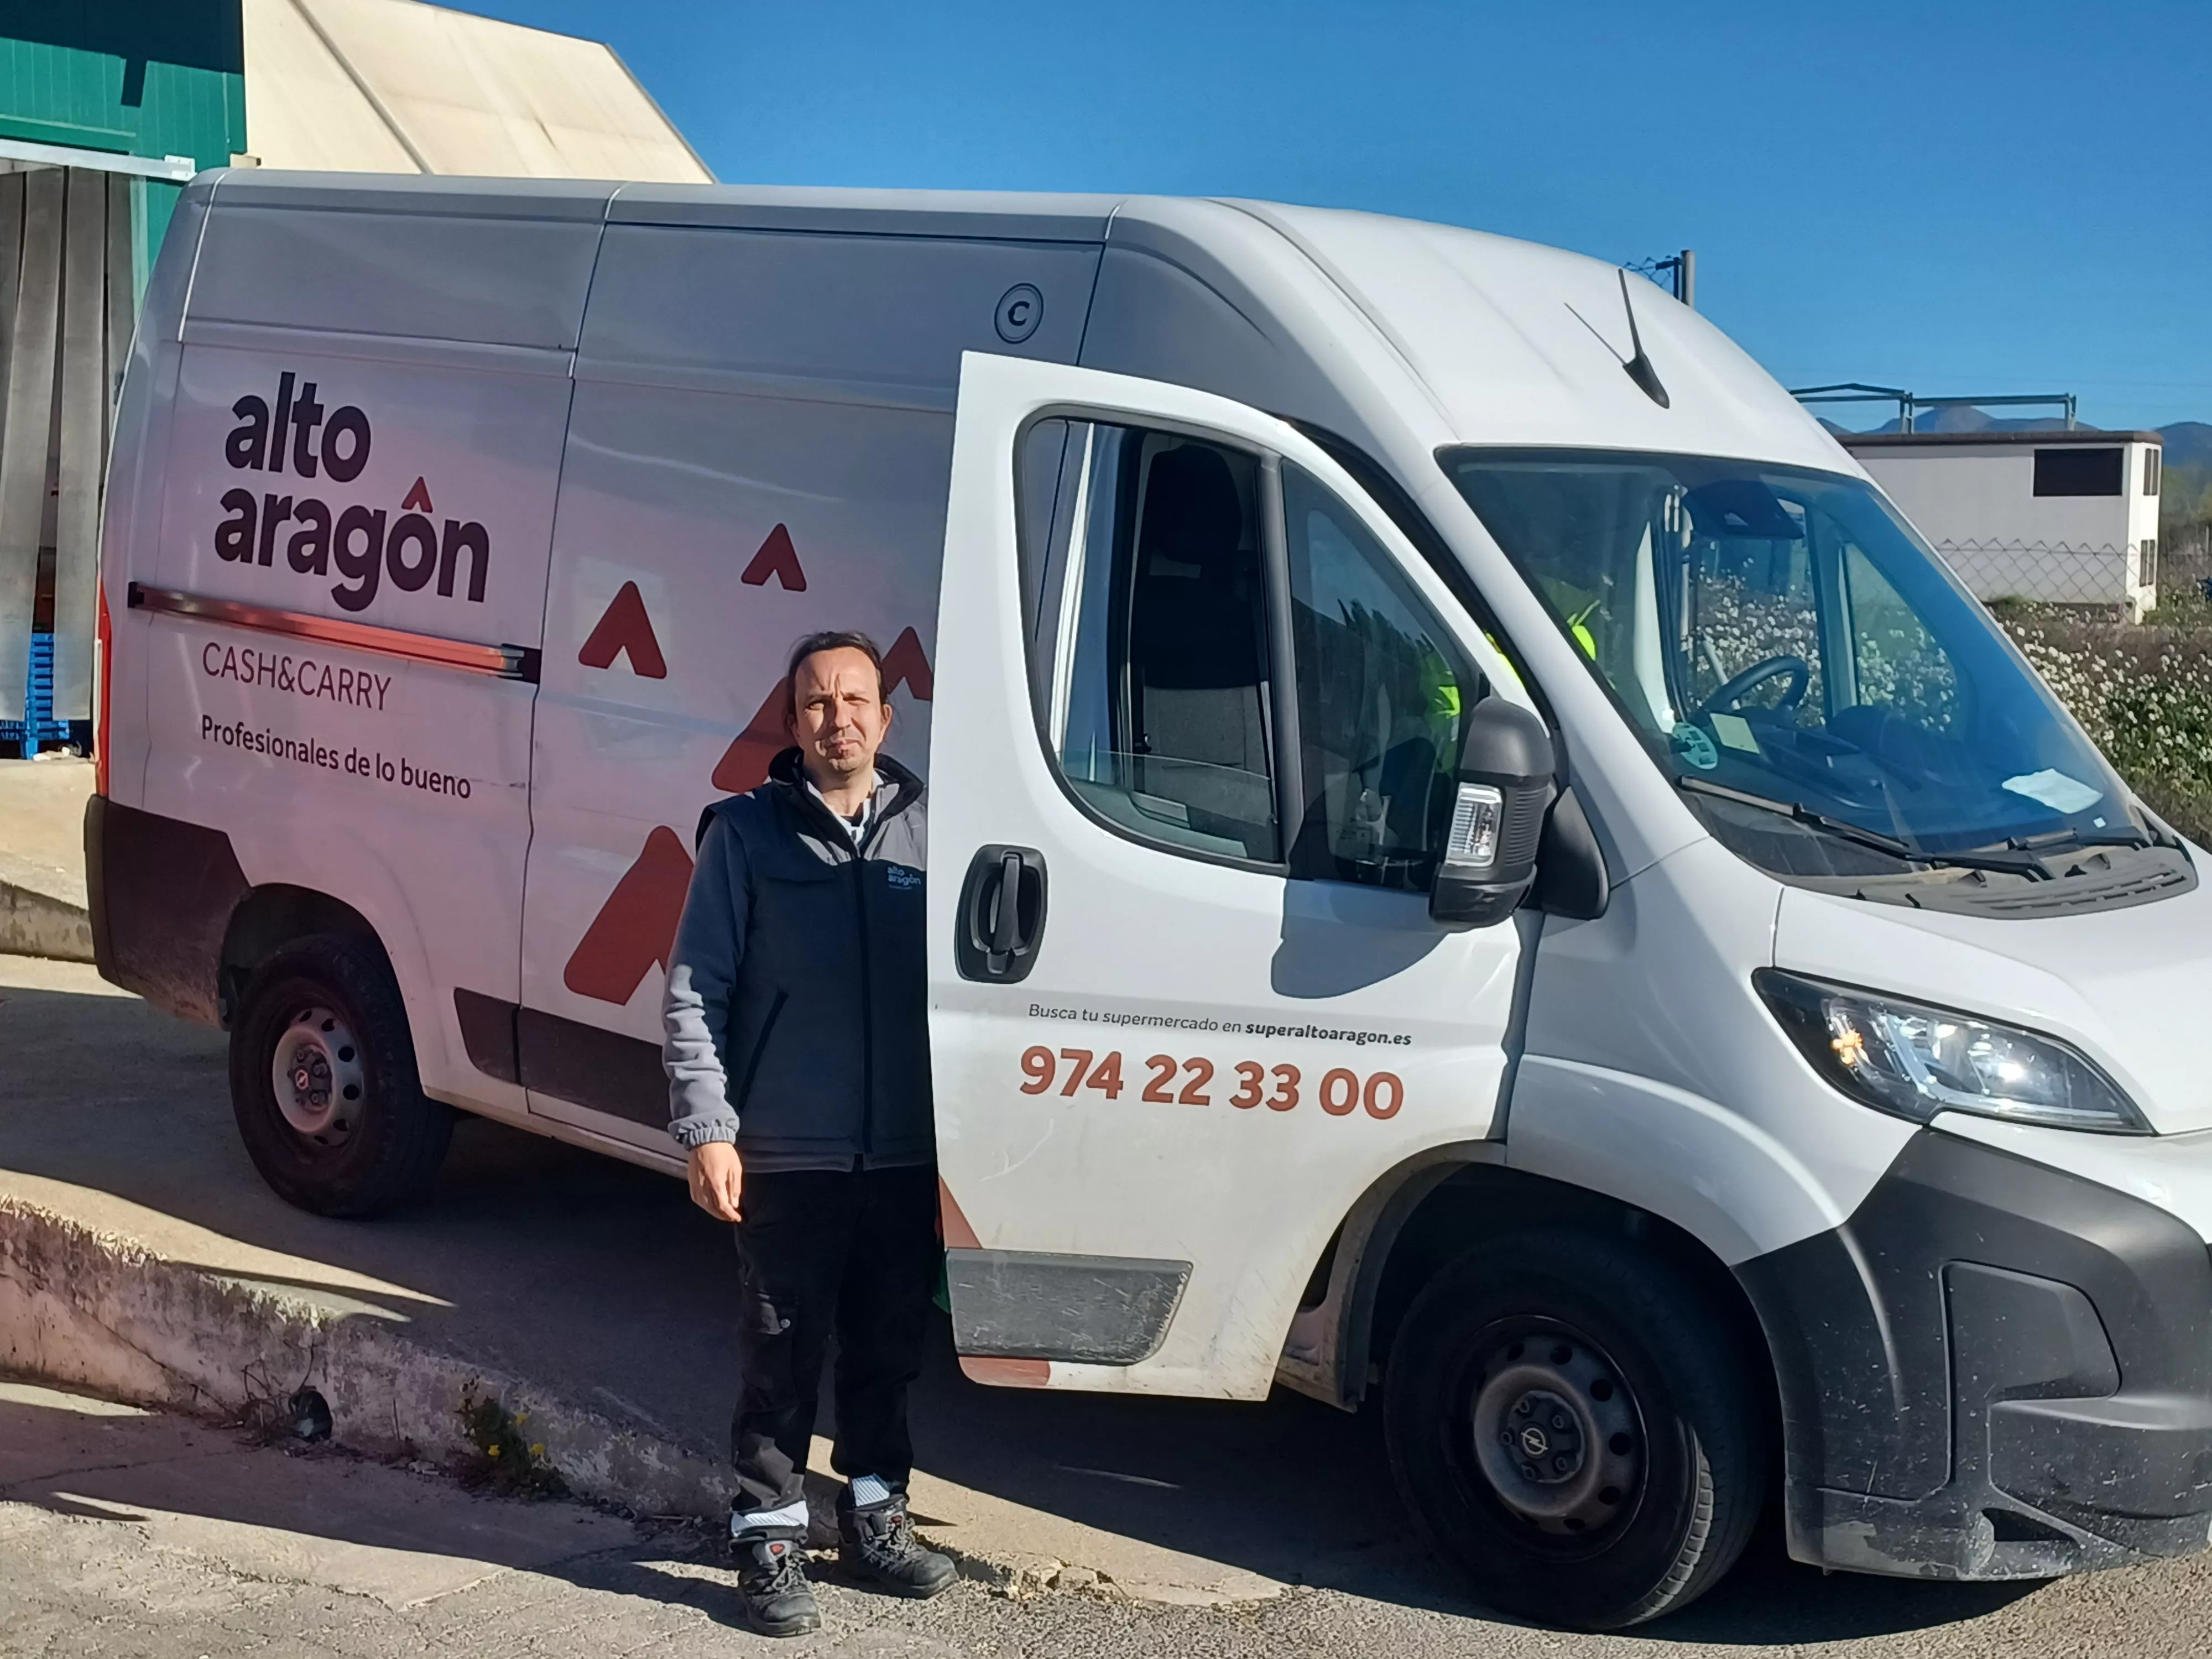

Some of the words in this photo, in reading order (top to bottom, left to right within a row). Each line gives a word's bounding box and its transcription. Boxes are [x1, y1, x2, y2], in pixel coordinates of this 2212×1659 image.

[225, 371, 371, 482] alto
[202, 641, 392, 711] CASH&CARRY
[201, 714, 338, 769] Profesionales
[344, 747, 370, 777] de
[375, 753, 395, 782] lo
[401, 758, 471, 799] bueno
[1028, 1003, 1077, 1021] Busca
[1081, 1009, 1099, 1022] tu
[1103, 1011, 1218, 1031] supermercado
[1222, 1020, 1241, 1034] en
[1245, 1022, 1412, 1046] superaltoaragon.es
[1020, 1045, 1124, 1100] 974
[1141, 1054, 1214, 1106] 22
[1229, 1060, 1301, 1112] 33
[1319, 1068, 1404, 1120] 00
